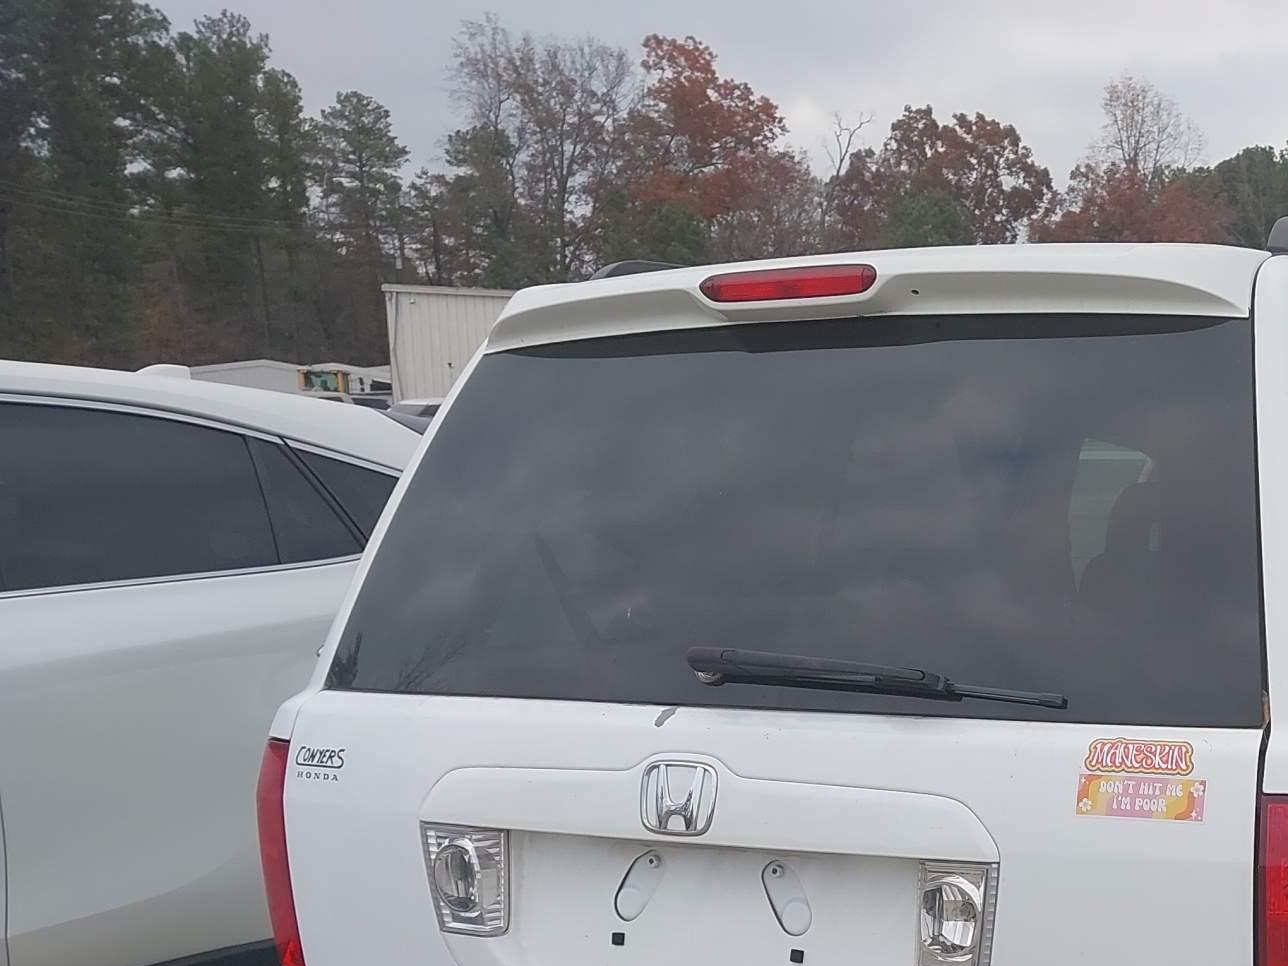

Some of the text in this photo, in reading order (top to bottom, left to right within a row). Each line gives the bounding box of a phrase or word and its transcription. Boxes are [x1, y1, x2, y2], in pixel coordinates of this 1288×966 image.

[296, 746, 346, 769] CONYERS
[296, 771, 339, 781] HONDA
[1099, 780, 1184, 797] DON'T HIT ME
[1112, 796, 1167, 813] I'M POOR
